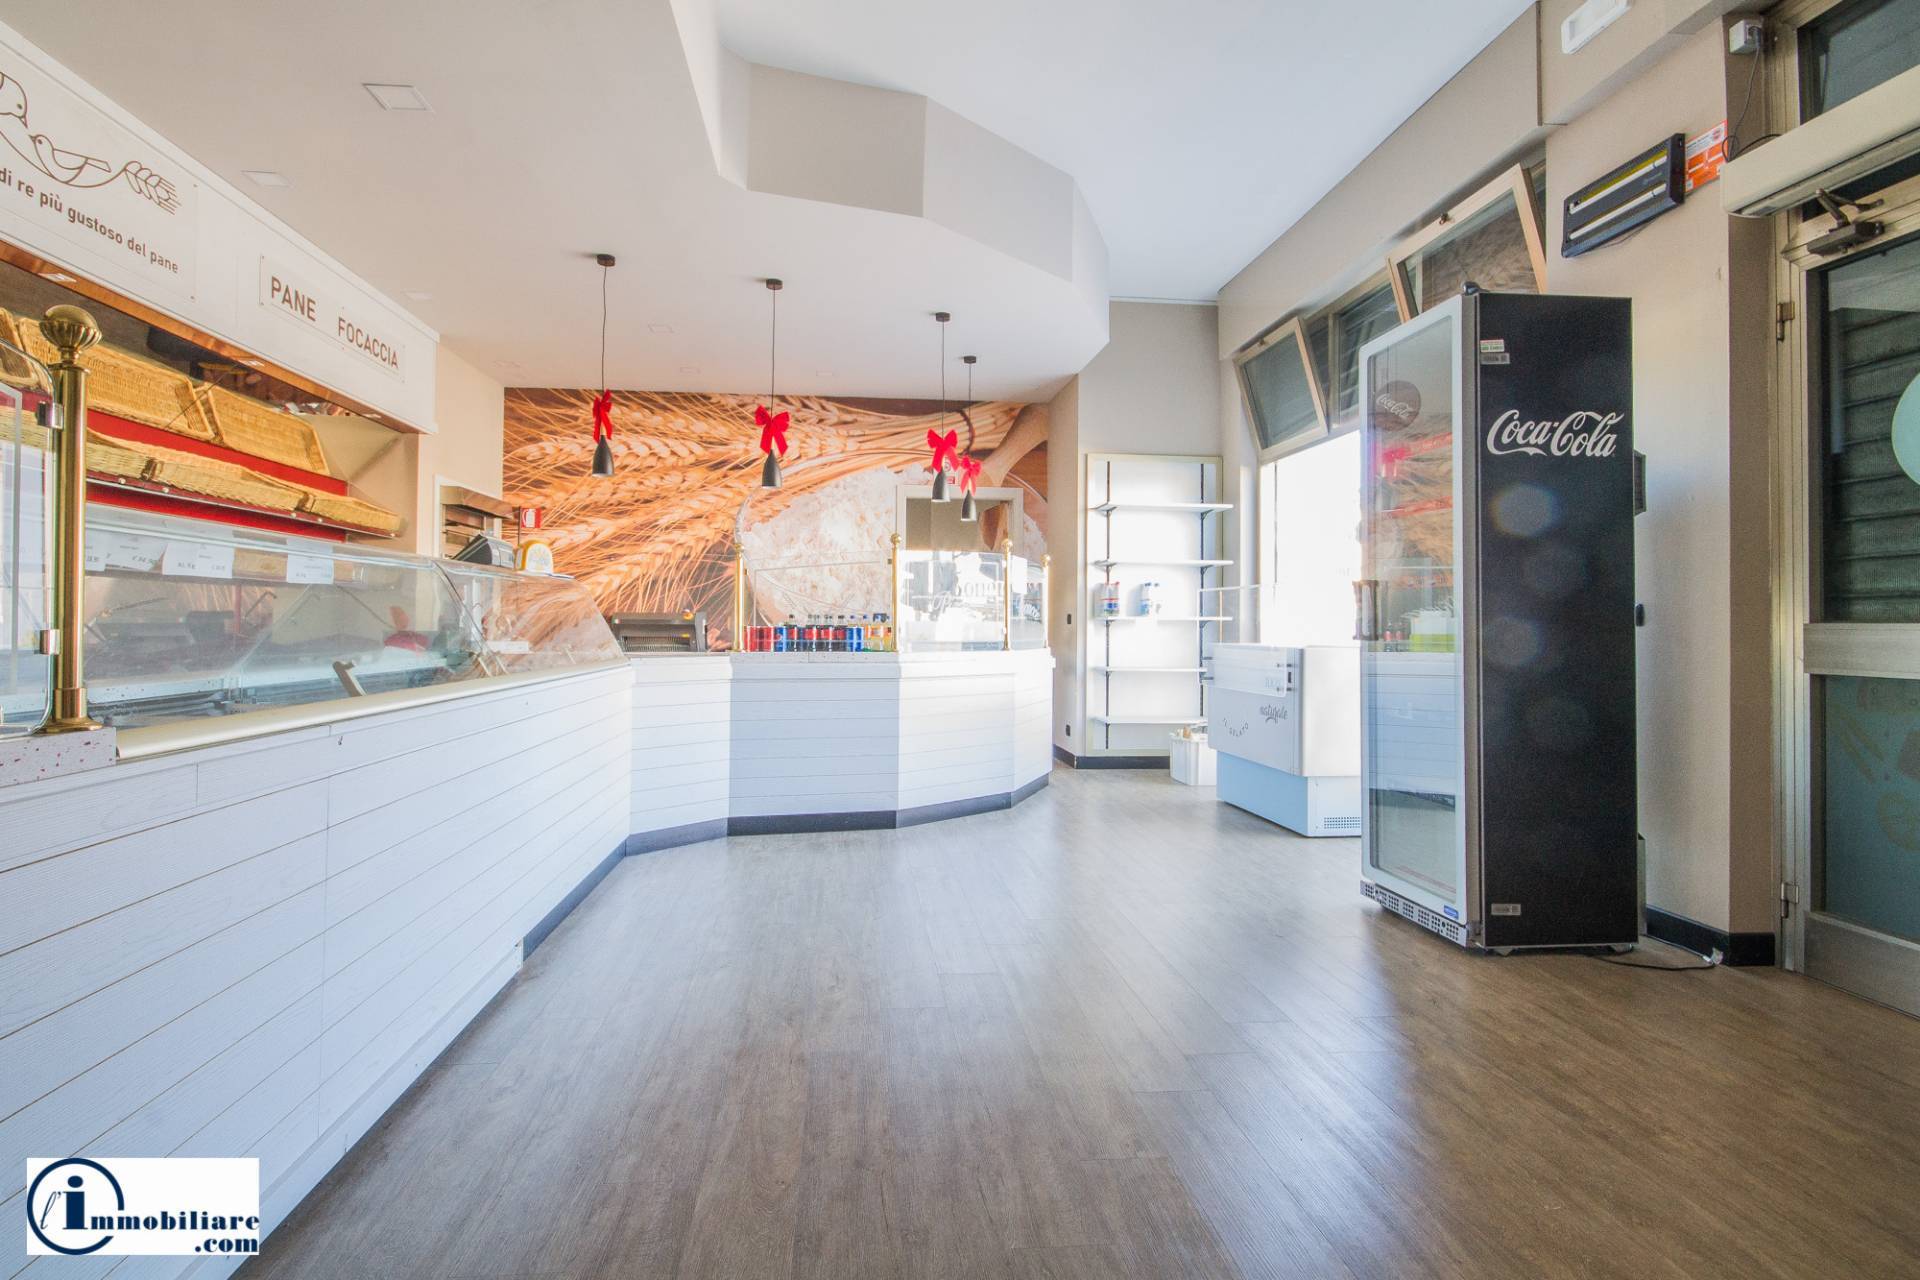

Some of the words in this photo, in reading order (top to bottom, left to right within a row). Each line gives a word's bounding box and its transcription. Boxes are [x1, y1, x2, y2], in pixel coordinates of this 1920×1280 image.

[17, 179, 35, 198] re
[40, 190, 63, 212] più
[67, 206, 123, 244] gustoso
[127, 236, 146, 257] del
[150, 251, 179, 274] pane
[271, 275, 316, 322] PANE
[338, 316, 399, 369] FOCACCIA
[1486, 409, 1625, 458] Coca-Cola
